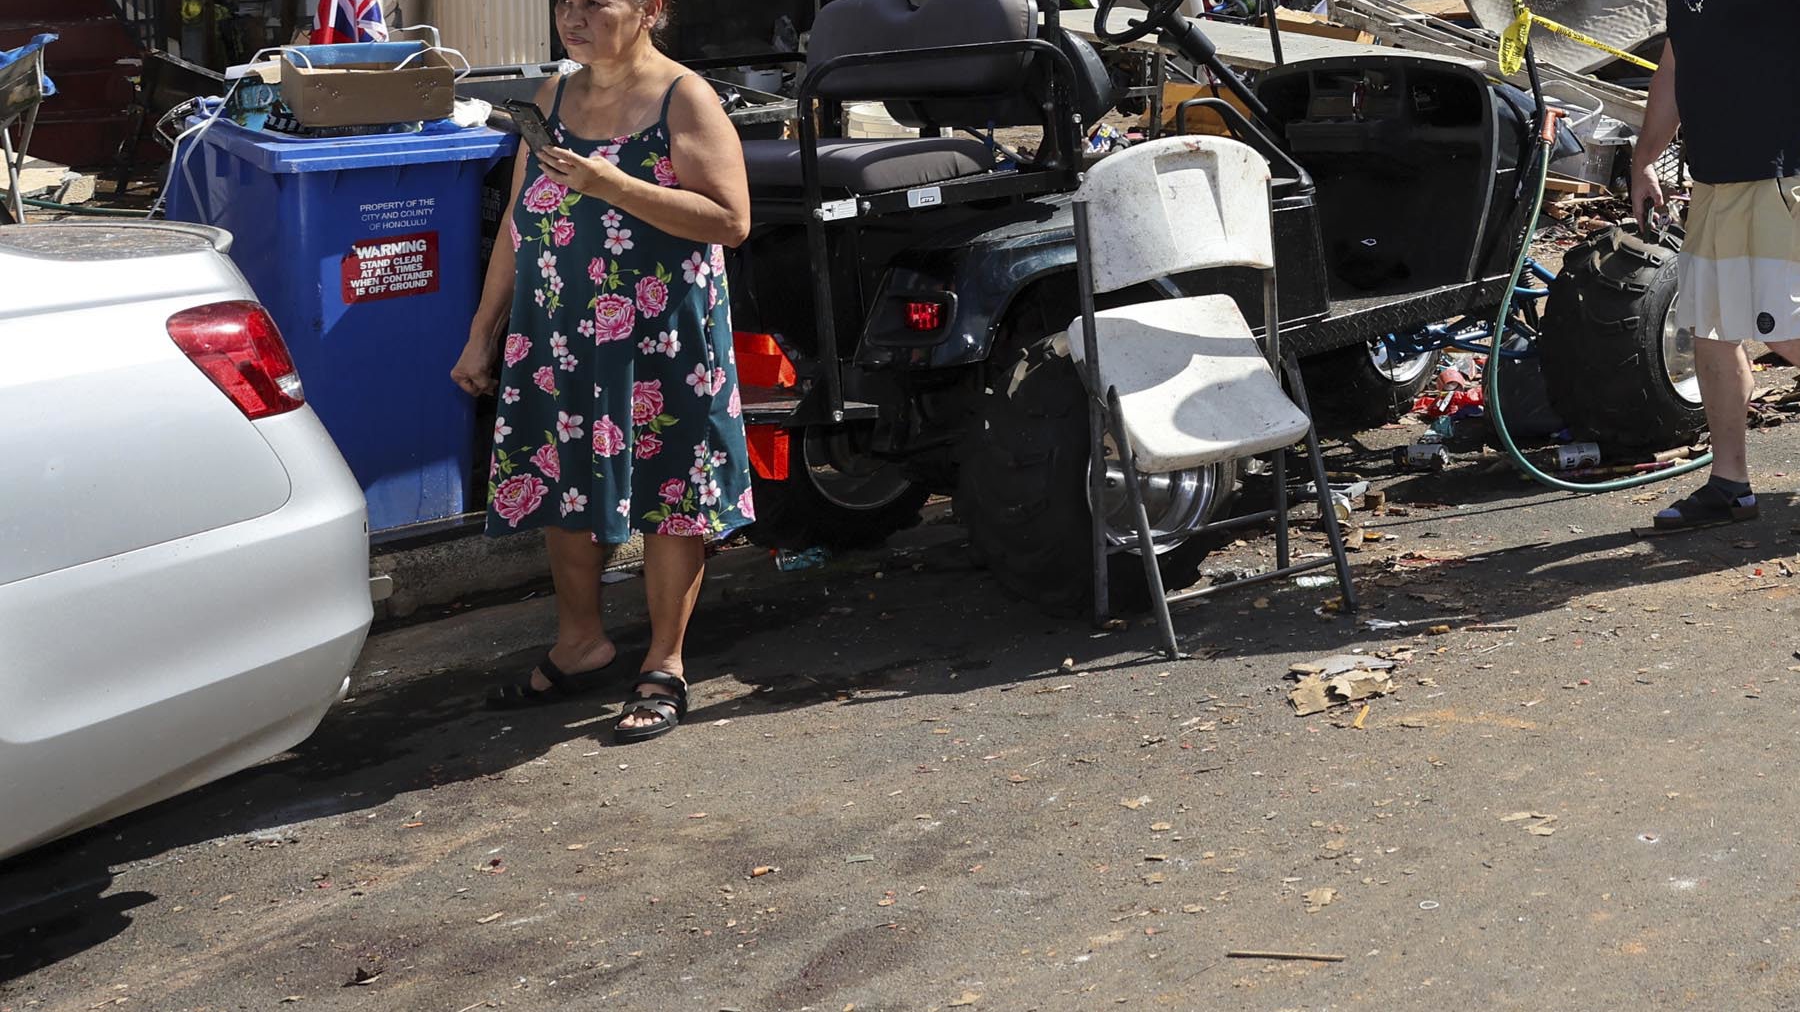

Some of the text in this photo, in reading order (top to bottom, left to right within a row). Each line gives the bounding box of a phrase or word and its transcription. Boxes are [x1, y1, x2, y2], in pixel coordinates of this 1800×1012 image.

[360, 197, 435, 212] PROPERTY OF THE
[361, 208, 434, 222] CITY AND COUNTY
[369, 218, 427, 231] OF HONOLULU
[354, 239, 427, 259] WARNING
[360, 255, 423, 269] STAND CLEAR
[361, 263, 423, 278] AT ALL TIMES
[350, 270, 433, 288] WHEN CONTAINER
[356, 279, 427, 296] IS OFF GROUND
